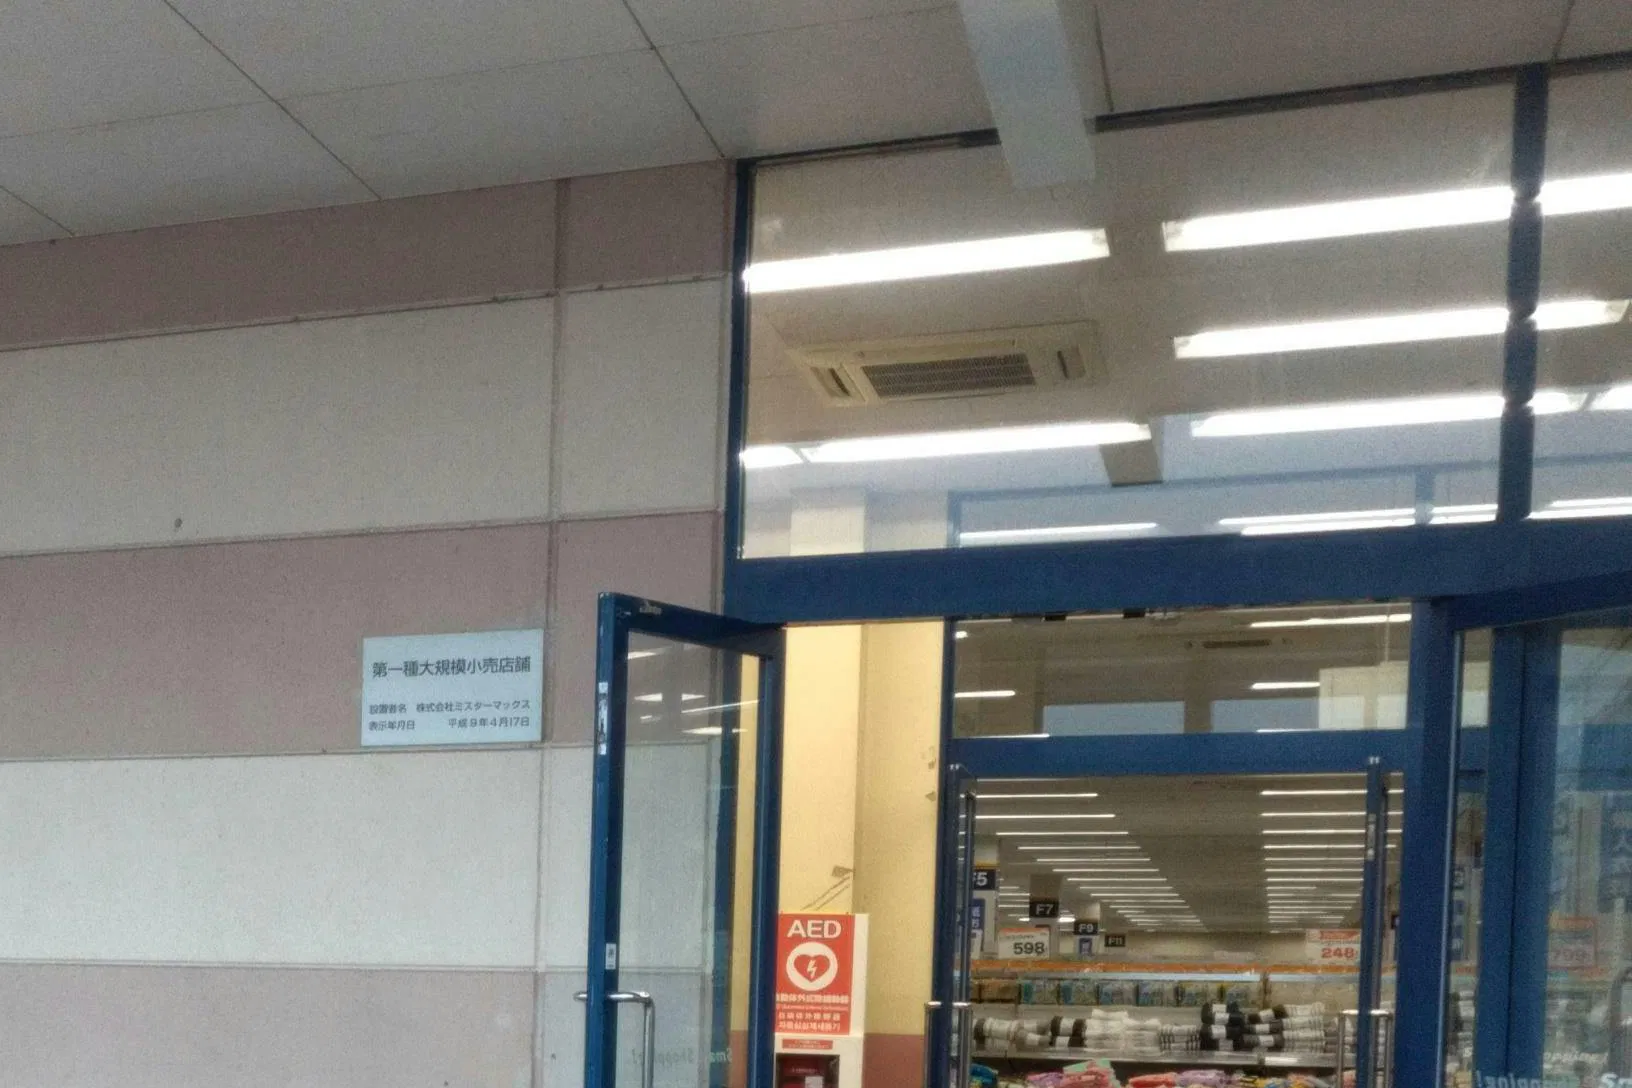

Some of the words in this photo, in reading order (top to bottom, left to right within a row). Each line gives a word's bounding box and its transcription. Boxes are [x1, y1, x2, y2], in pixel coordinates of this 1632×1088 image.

[372, 656, 531, 678] 第一種大規模小売店舗
[416, 699, 531, 713] 株式会社ミスターマックス
[1036, 903, 1054, 914] F7
[787, 919, 842, 939] AED
[1078, 924, 1094, 933] F9
[1013, 942, 1045, 955] 598
[1321, 947, 1355, 959] 248
